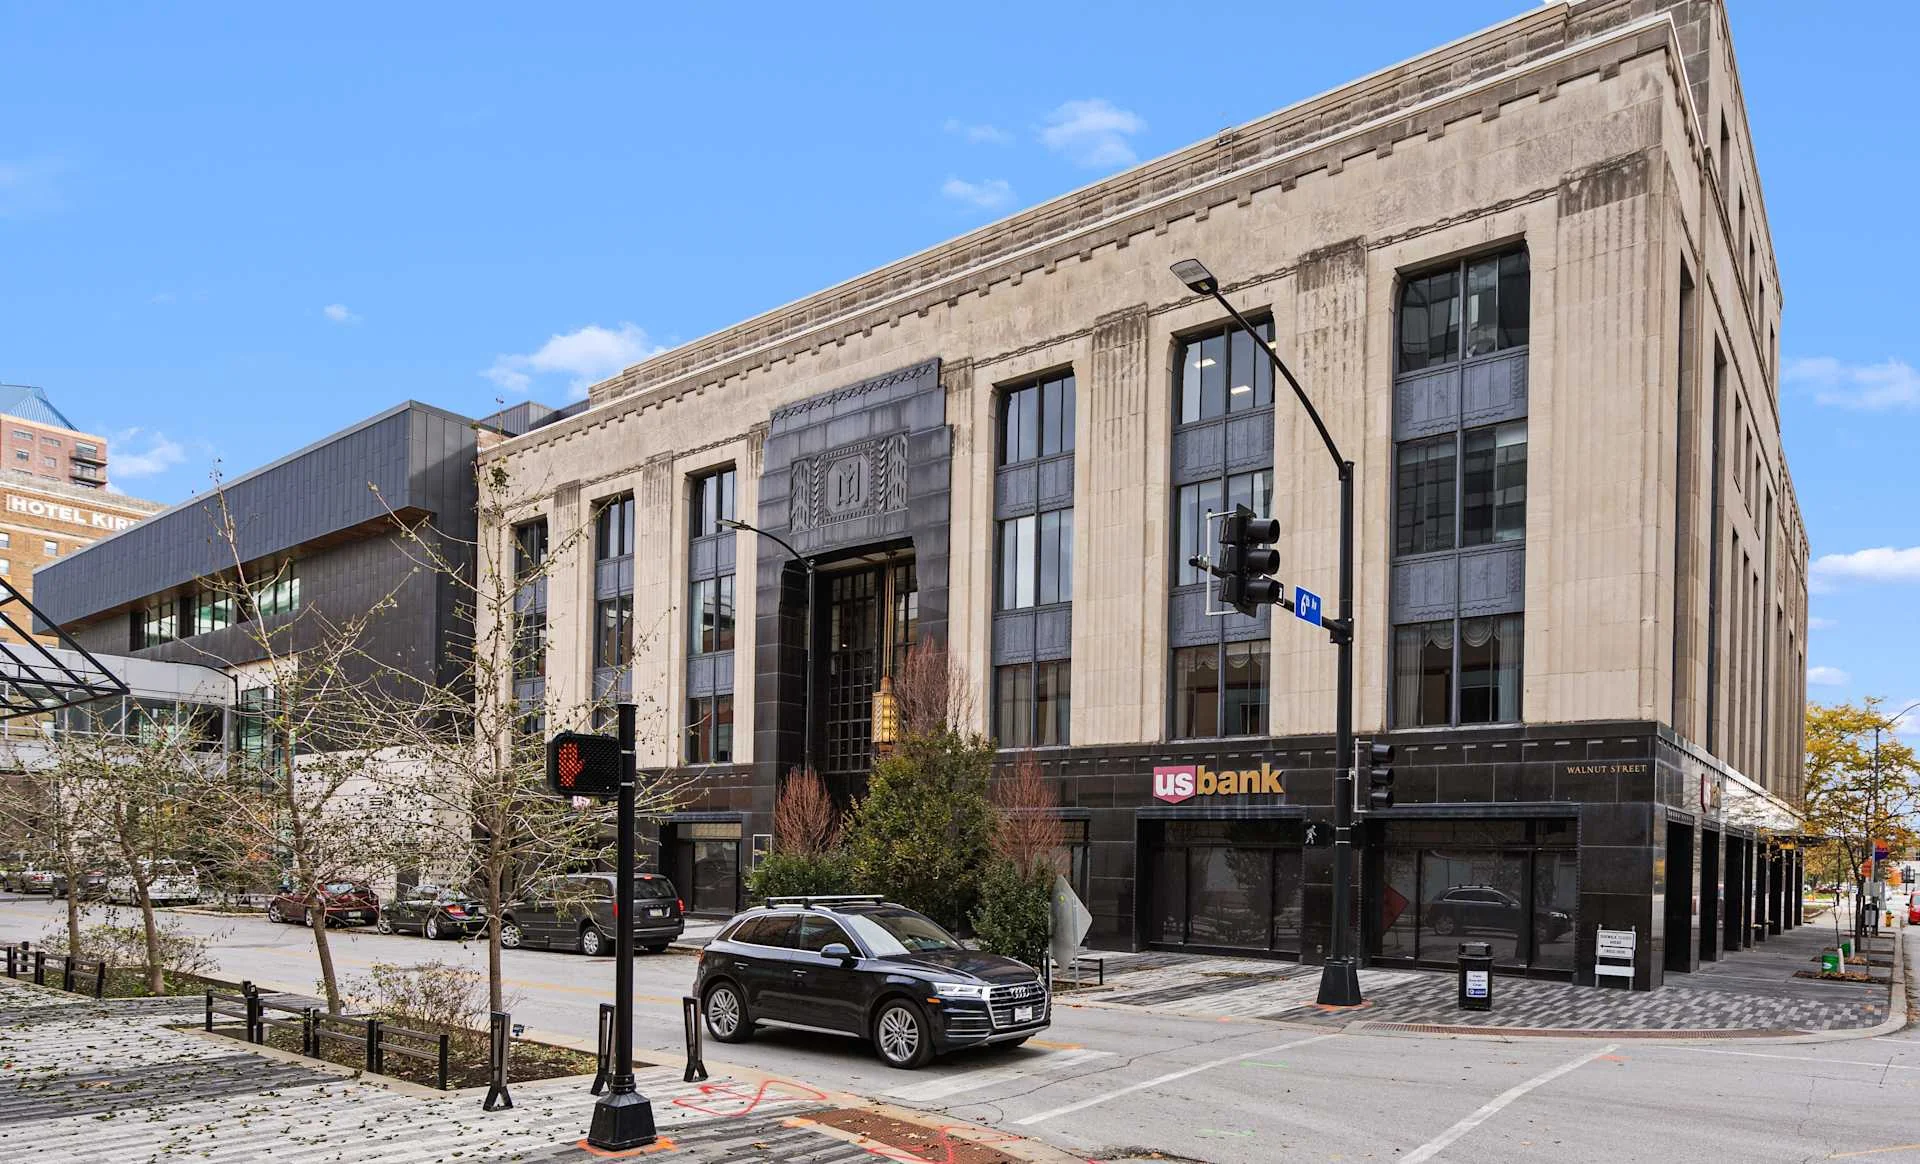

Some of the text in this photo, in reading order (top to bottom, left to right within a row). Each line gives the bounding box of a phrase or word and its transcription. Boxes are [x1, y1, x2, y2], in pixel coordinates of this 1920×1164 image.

[11, 497, 87, 525] HOTEL
[1301, 593, 1310, 616] 6th
[1567, 764, 1648, 774] WALNUT STREET
